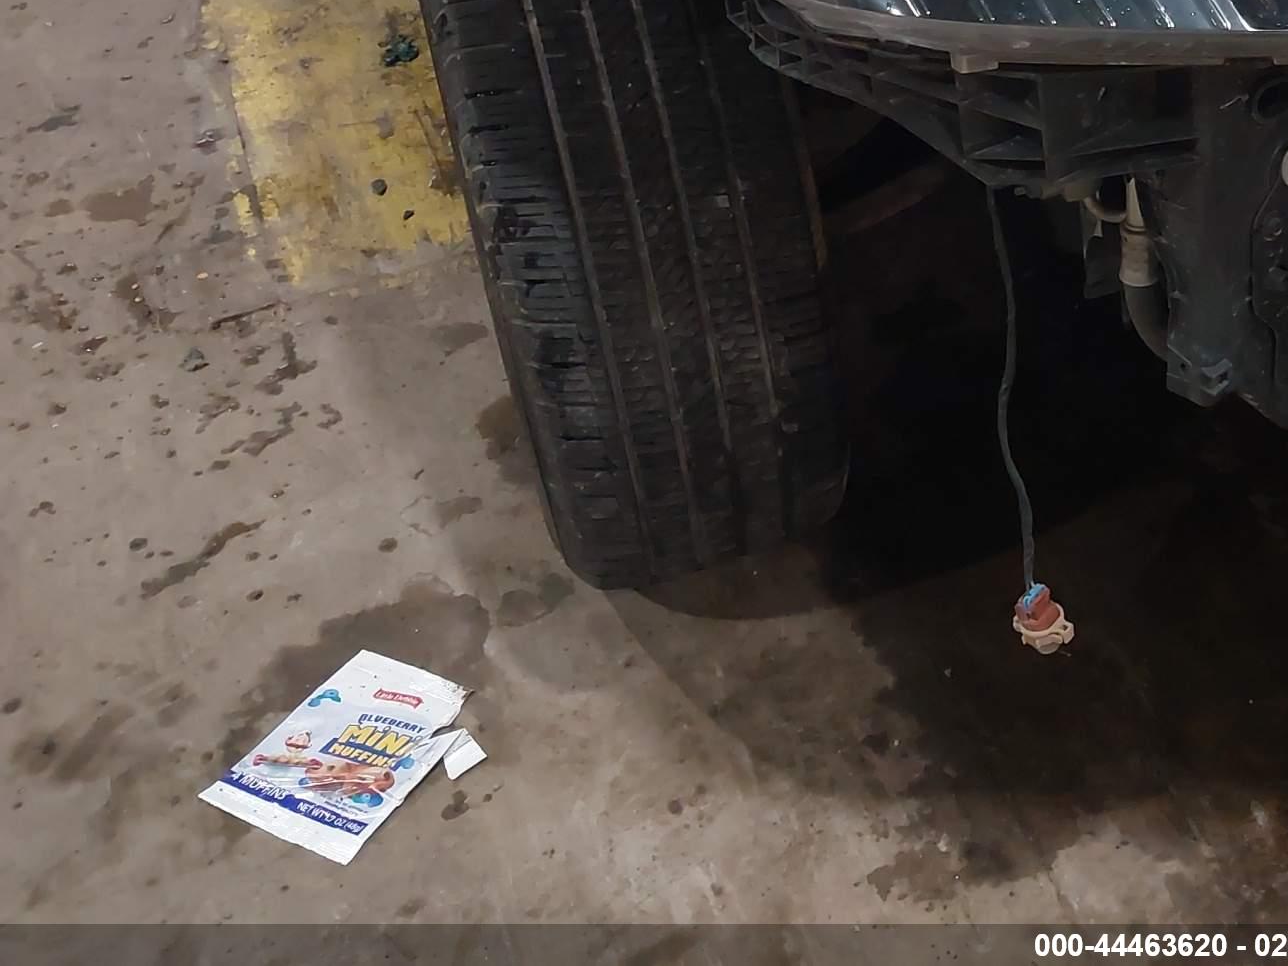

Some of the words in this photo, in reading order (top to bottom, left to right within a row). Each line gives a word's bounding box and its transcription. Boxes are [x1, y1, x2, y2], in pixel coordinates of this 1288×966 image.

[357, 713, 426, 734] BLUEBERRY
[239, 774, 290, 800] MUFFINS
[296, 801, 315, 813] NET
